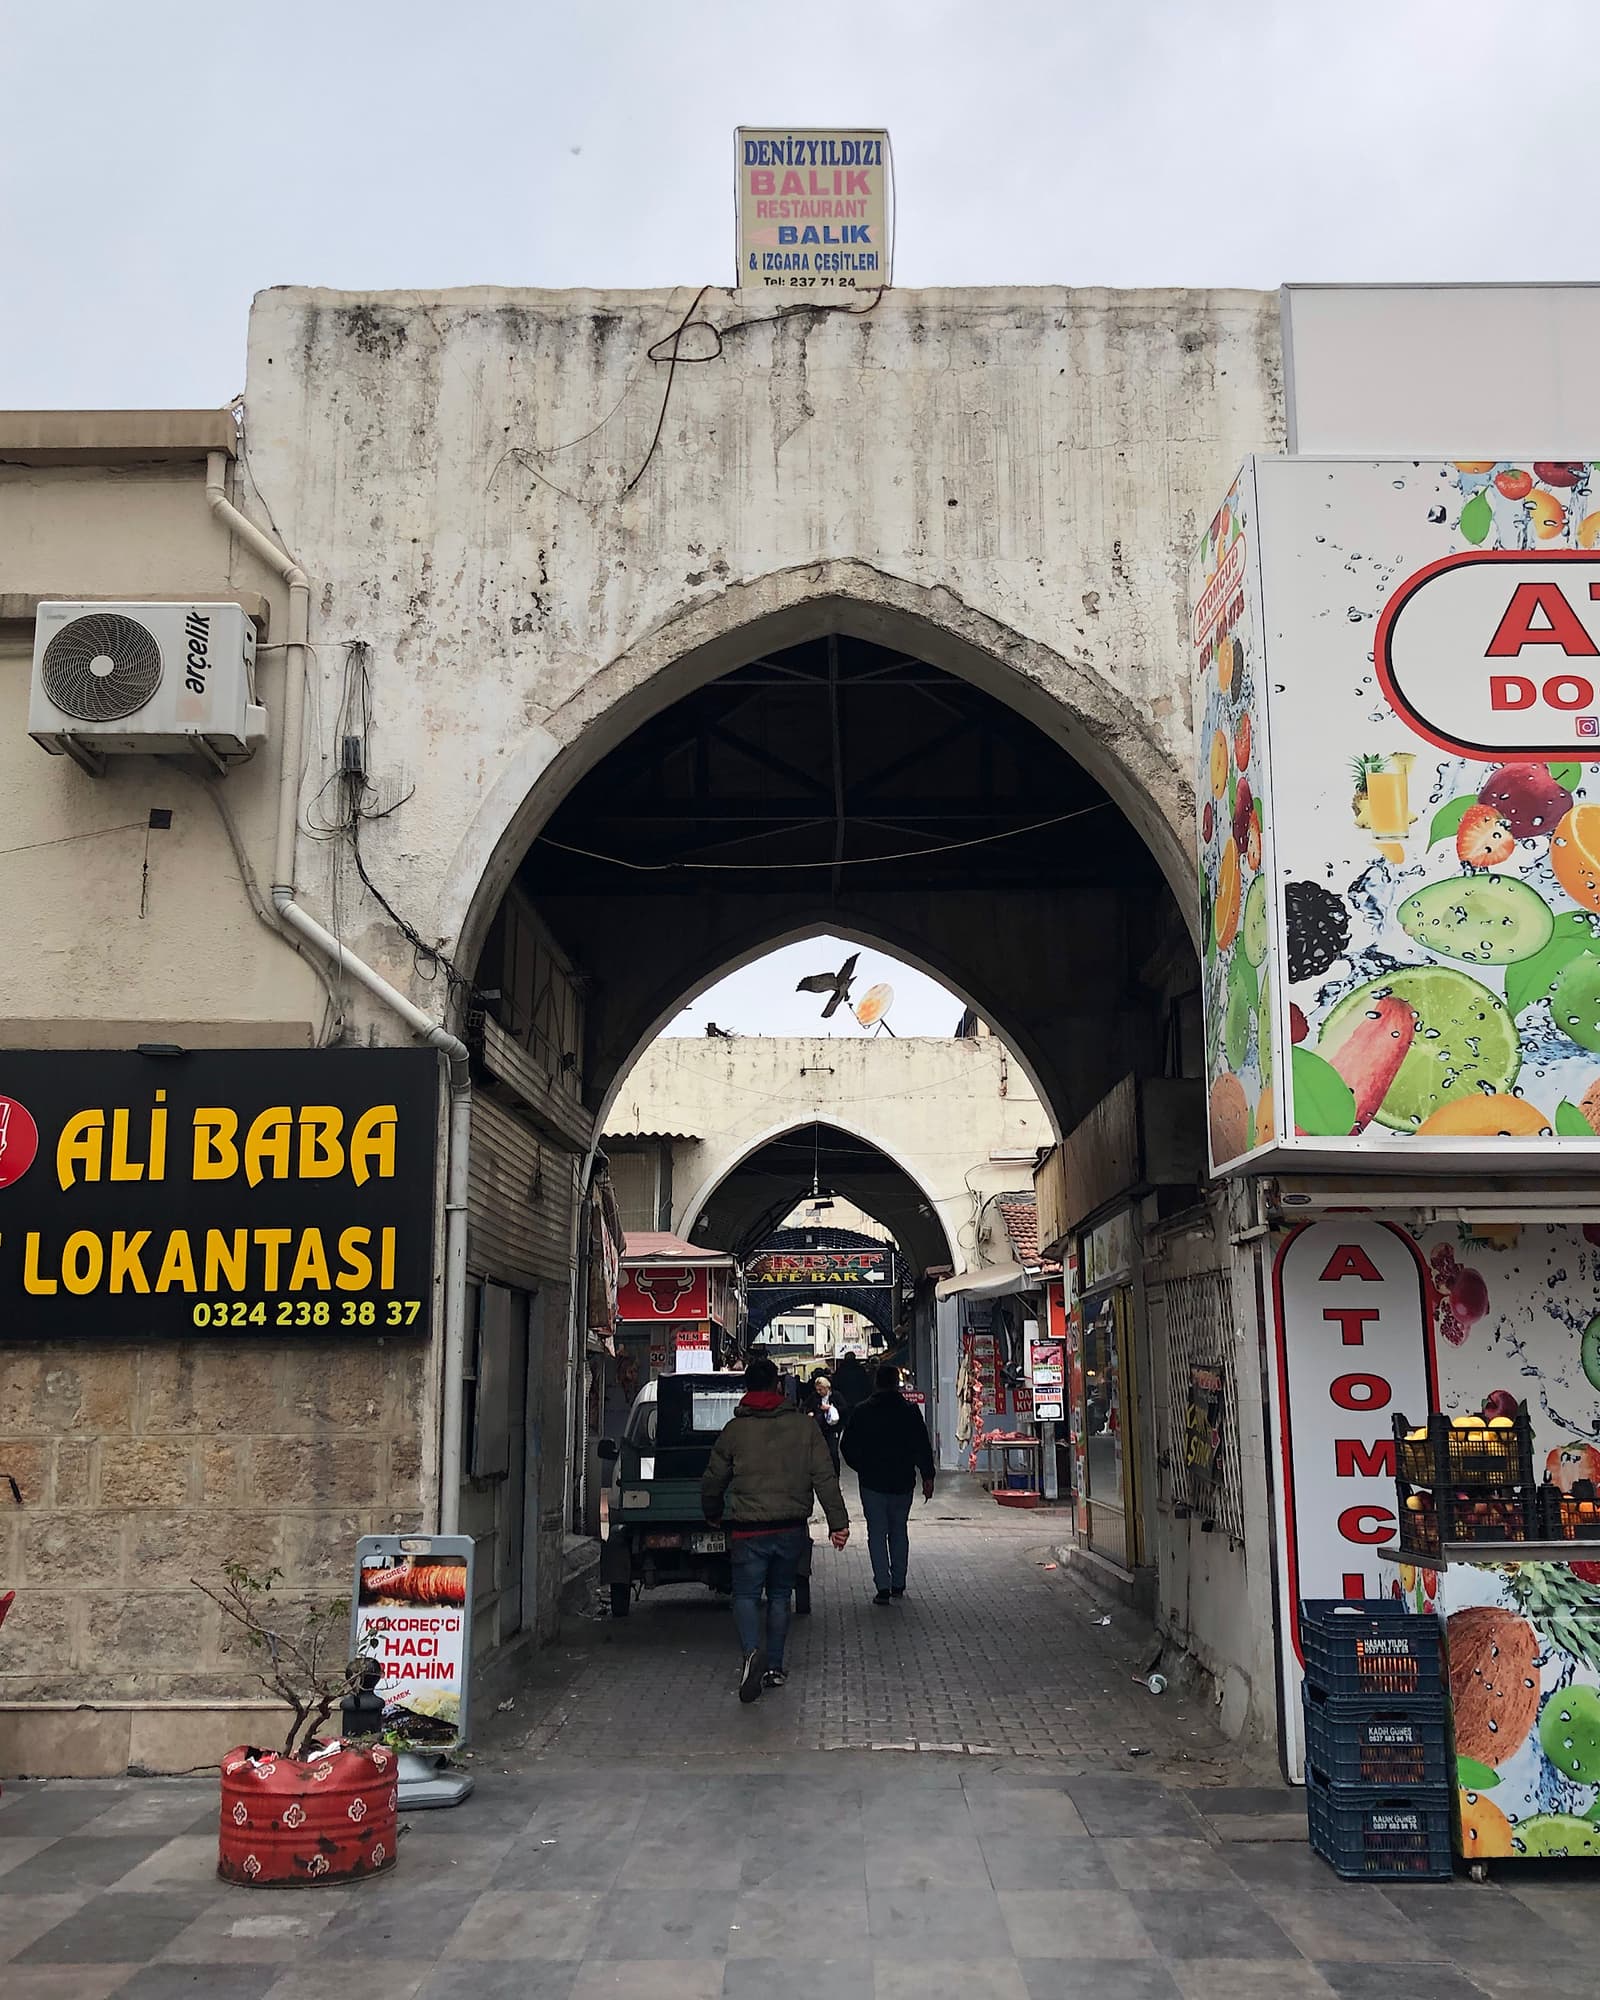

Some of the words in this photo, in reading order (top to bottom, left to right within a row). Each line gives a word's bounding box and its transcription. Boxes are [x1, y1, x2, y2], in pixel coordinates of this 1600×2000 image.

[744, 136, 882, 166] DENİZYILDIZI
[750, 170, 872, 196] BALIK
[756, 199, 867, 219] RESTAURANT
[778, 225, 871, 245] BALIK
[749, 253, 758, 271] &
[762, 253, 809, 271] IZGARA
[814, 251, 878, 274] ÇEŞİTLERİ
[790, 277, 815, 287] 237
[838, 277, 856, 287] 24
[1484, 582, 1600, 657] A
[185, 612, 210, 694] arçelik
[1490, 676, 1600, 711] DO
[57, 1089, 167, 1191] ALİ
[193, 1105, 398, 1188] BABA
[24, 1227, 396, 1295] LOKANTASI
[811, 1272, 859, 1281] BAR
[193, 1303, 267, 1327] 0324
[276, 1303, 330, 1326] 238
[340, 1302, 376, 1326] 38
[386, 1301, 421, 1326] 37
[370, 1565, 408, 1586] KOKOREÇ
[365, 1616, 460, 1635] KOKOREÇ'Cİ
[385, 1638, 438, 1657] HACI
[380, 1659, 454, 1679] BRAHİM
